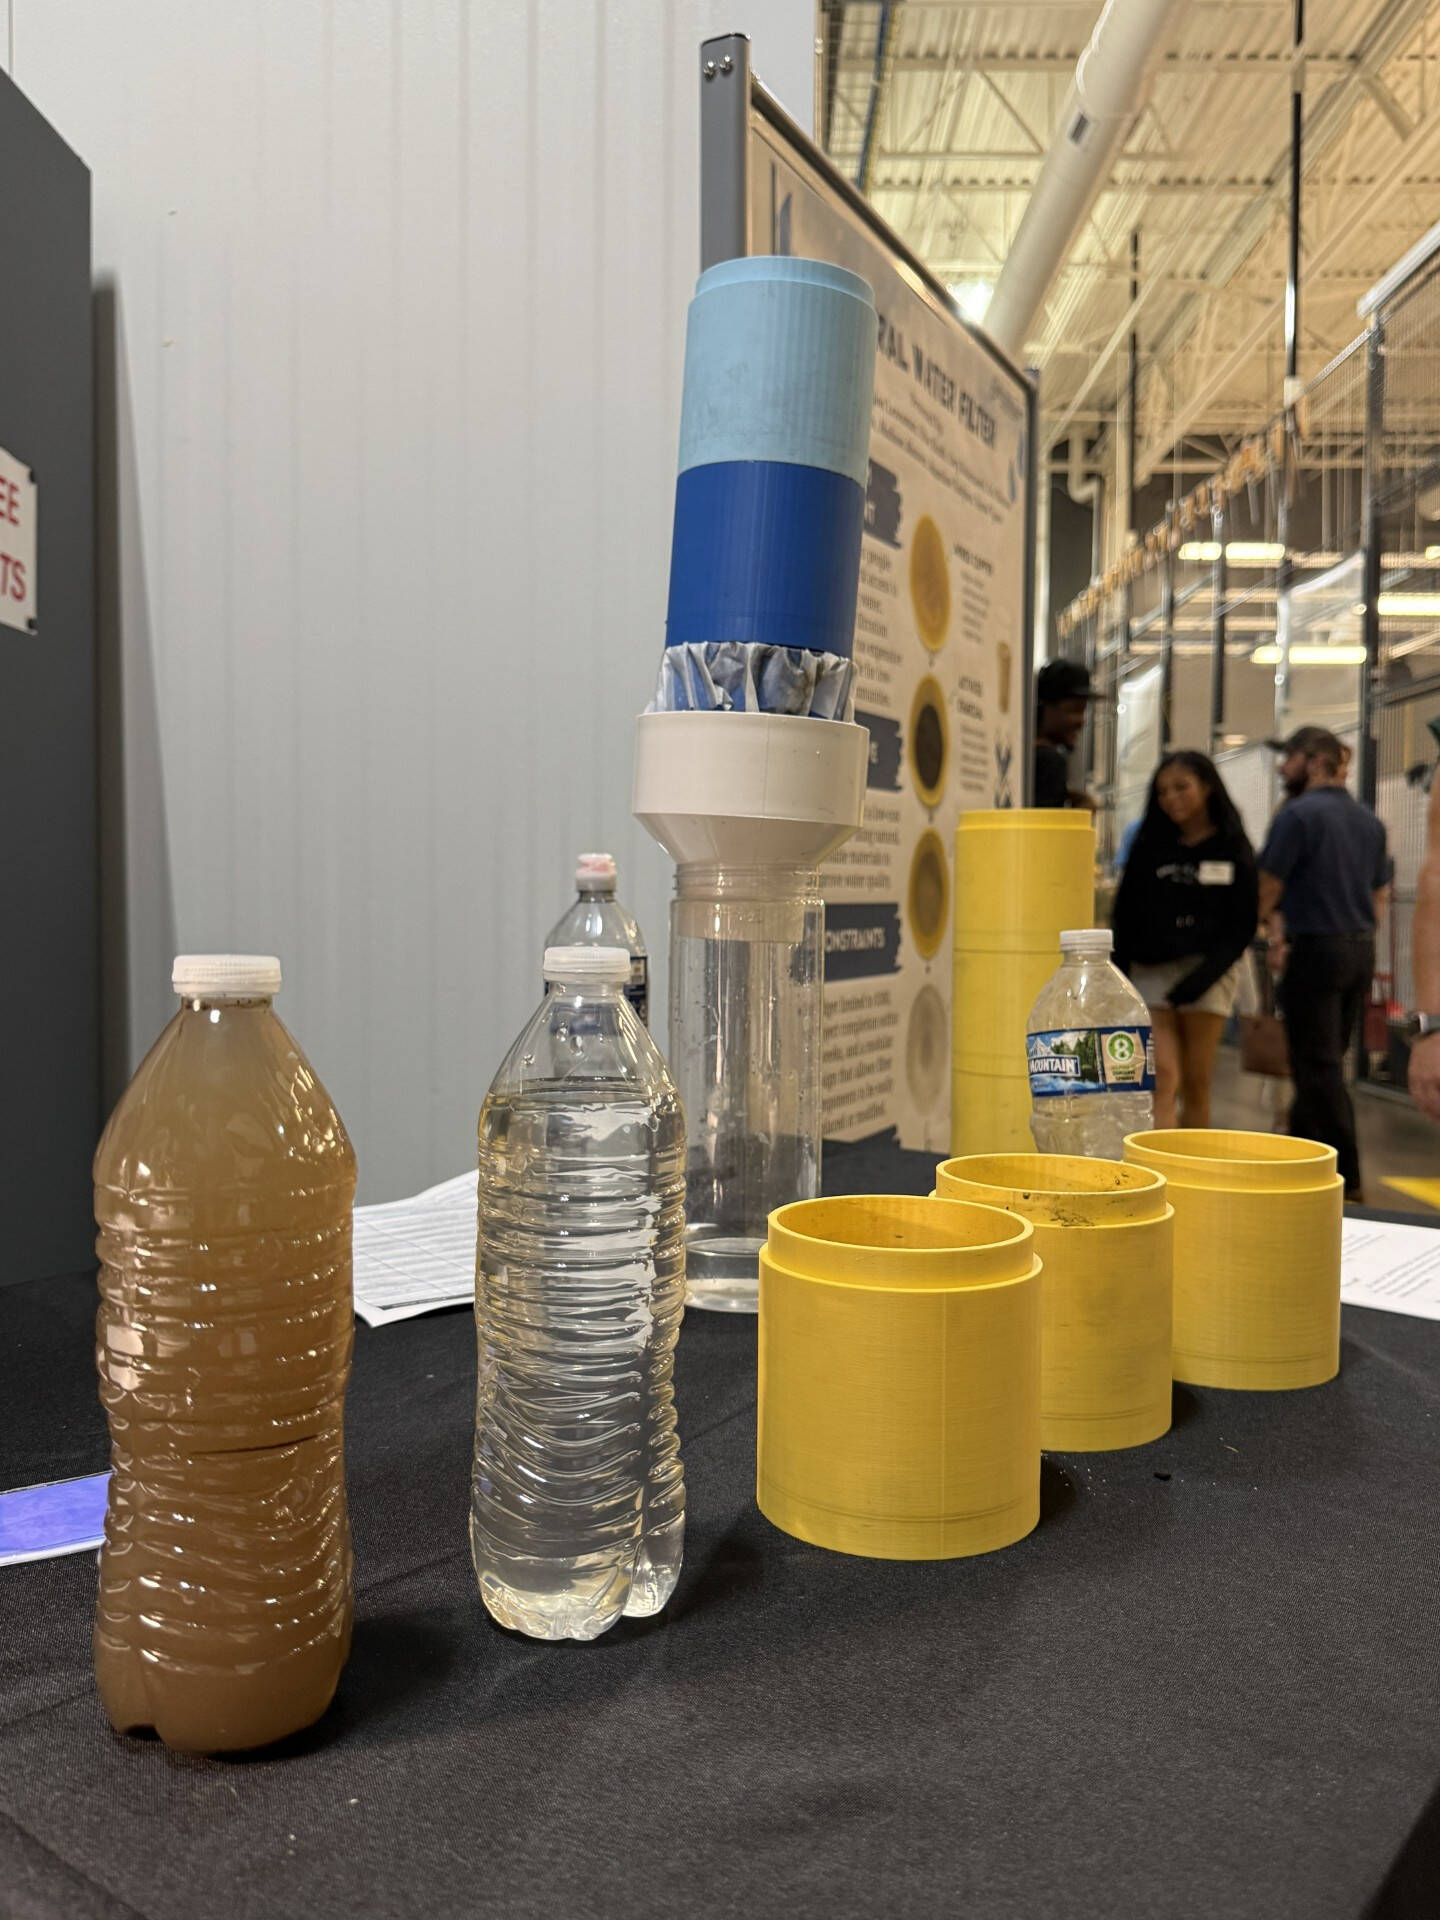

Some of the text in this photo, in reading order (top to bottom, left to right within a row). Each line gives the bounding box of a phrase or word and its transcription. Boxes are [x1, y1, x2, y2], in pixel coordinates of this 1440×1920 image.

[912, 343, 954, 415] WATER
[958, 390, 995, 450] FILTER
[0, 552, 26, 602] TS
[1030, 1058, 1076, 1073] MOUNTAIN
